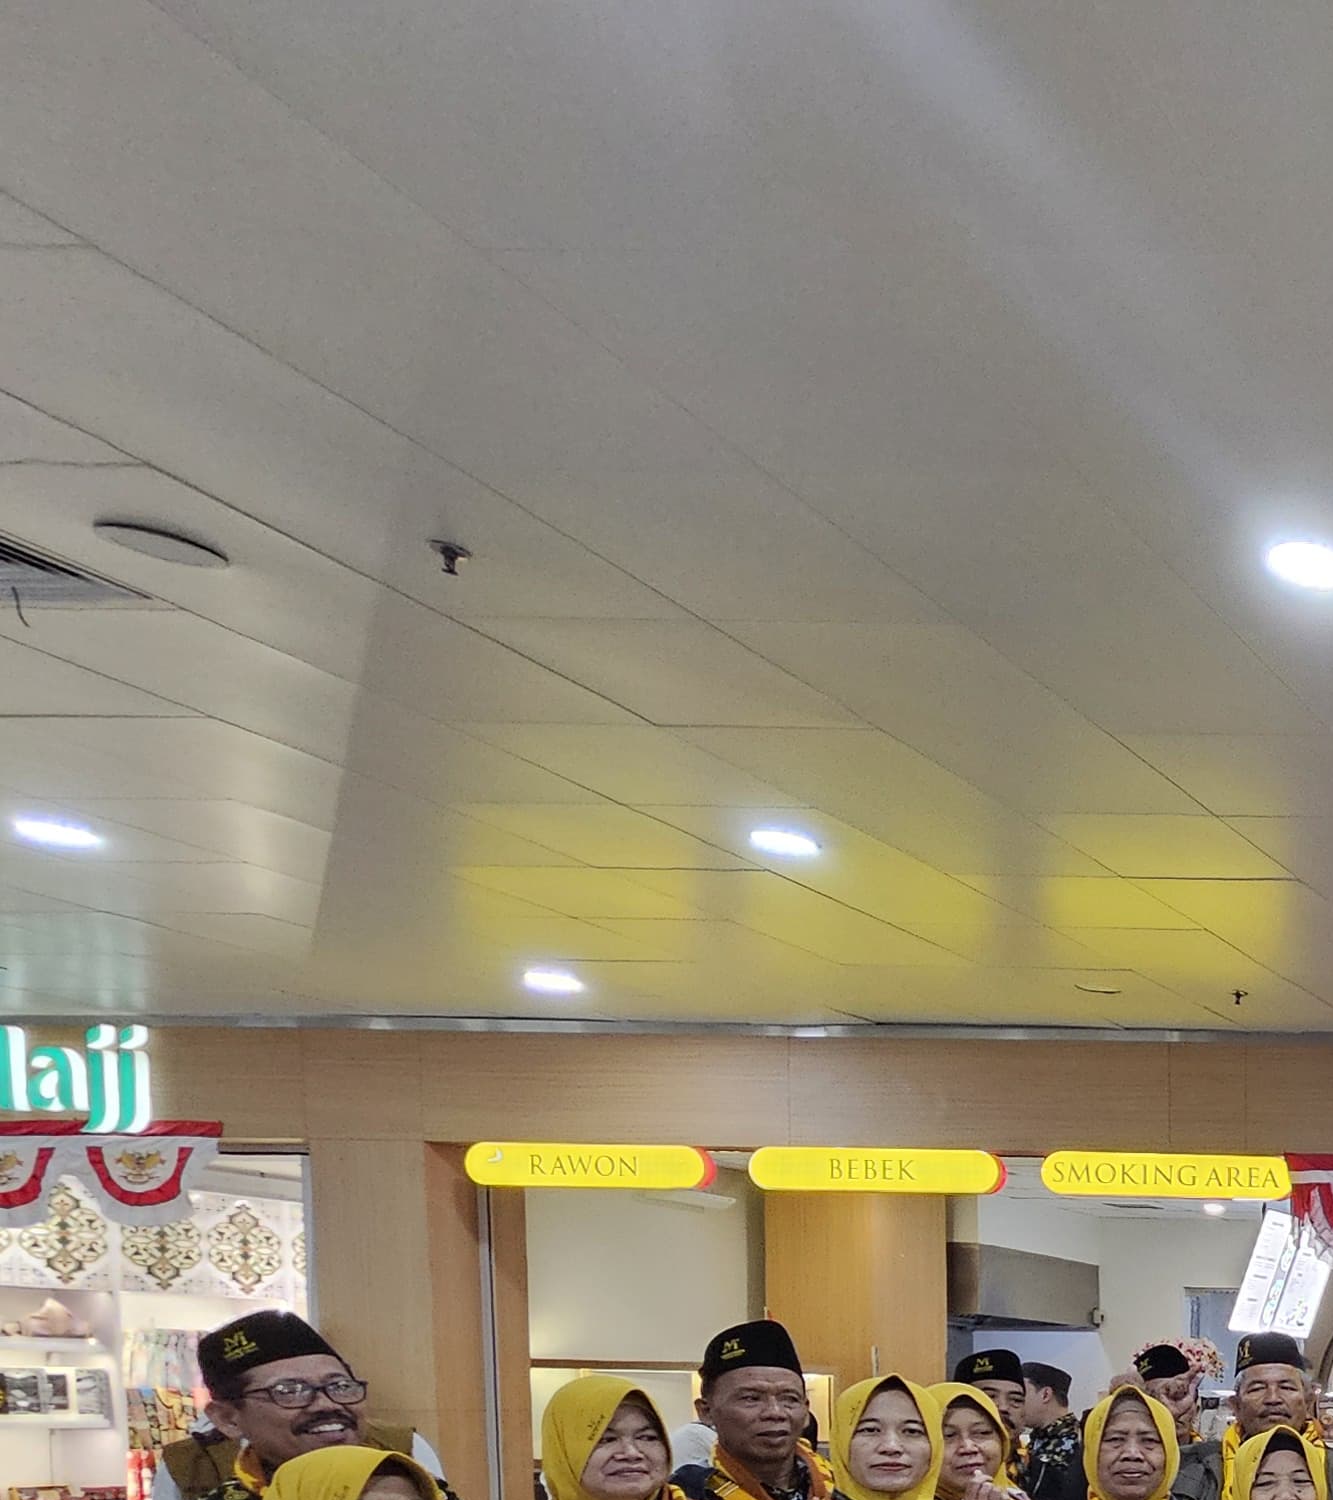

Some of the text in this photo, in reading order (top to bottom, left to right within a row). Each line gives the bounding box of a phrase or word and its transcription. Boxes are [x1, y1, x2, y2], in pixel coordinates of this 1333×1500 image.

[529, 1154, 638, 1177] RAWON
[829, 1158, 917, 1181] BEBEK
[1052, 1161, 1280, 1189] SMOKING AREA
